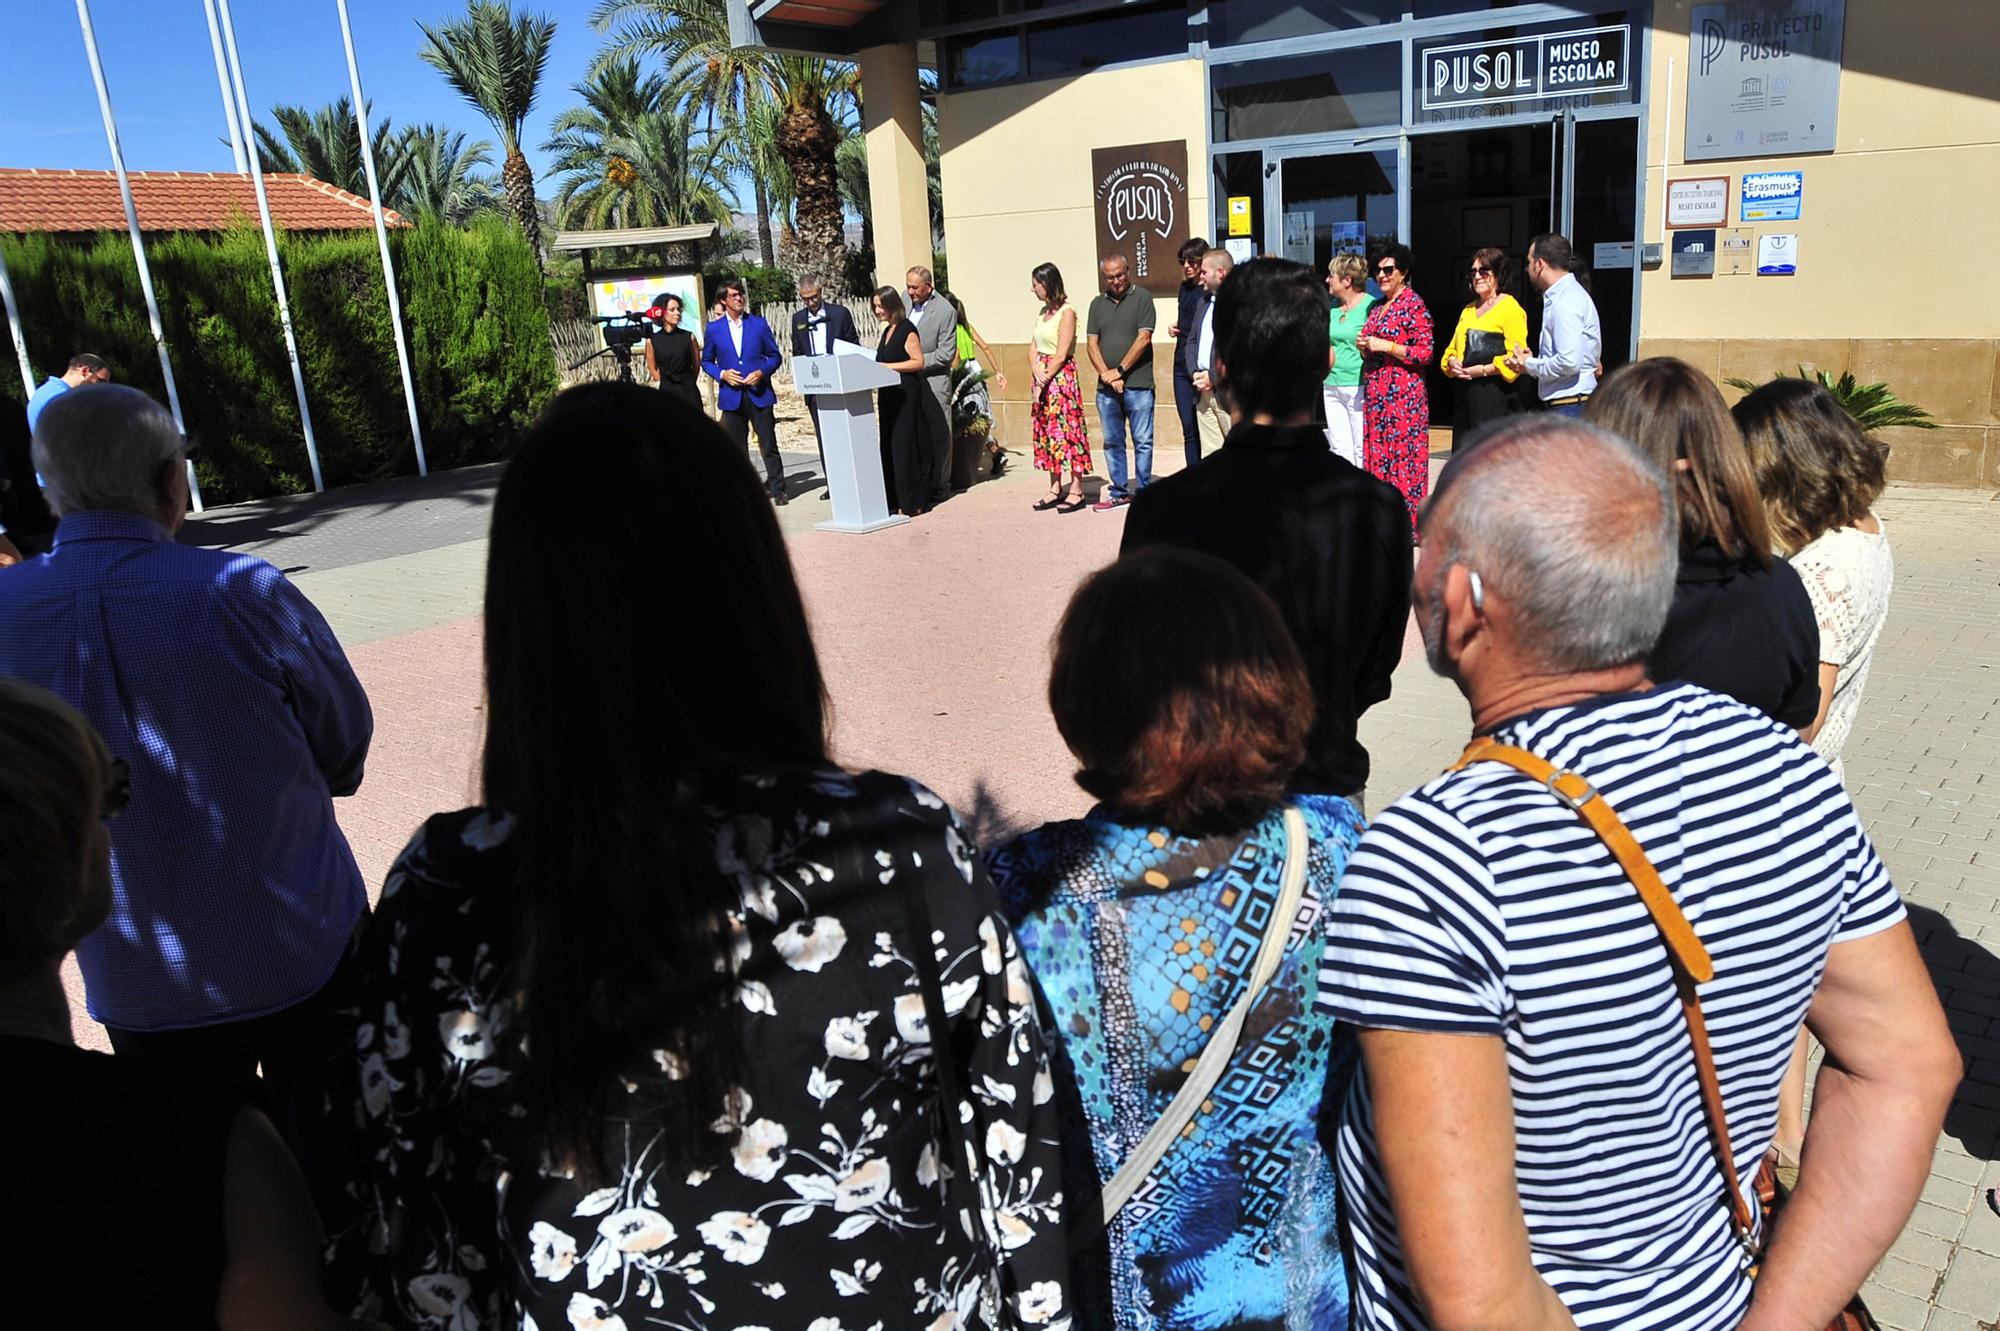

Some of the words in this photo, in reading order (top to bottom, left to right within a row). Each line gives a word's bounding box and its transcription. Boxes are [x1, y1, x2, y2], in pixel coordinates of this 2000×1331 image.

[1741, 14, 1823, 40] PROYECTO
[1550, 40, 1600, 64] MUSEO
[1740, 40, 1791, 62] PUSOL
[1434, 49, 1532, 96] PUSOL
[1549, 60, 1616, 85] ESCOLAR
[1116, 186, 1166, 226] PUSOL
